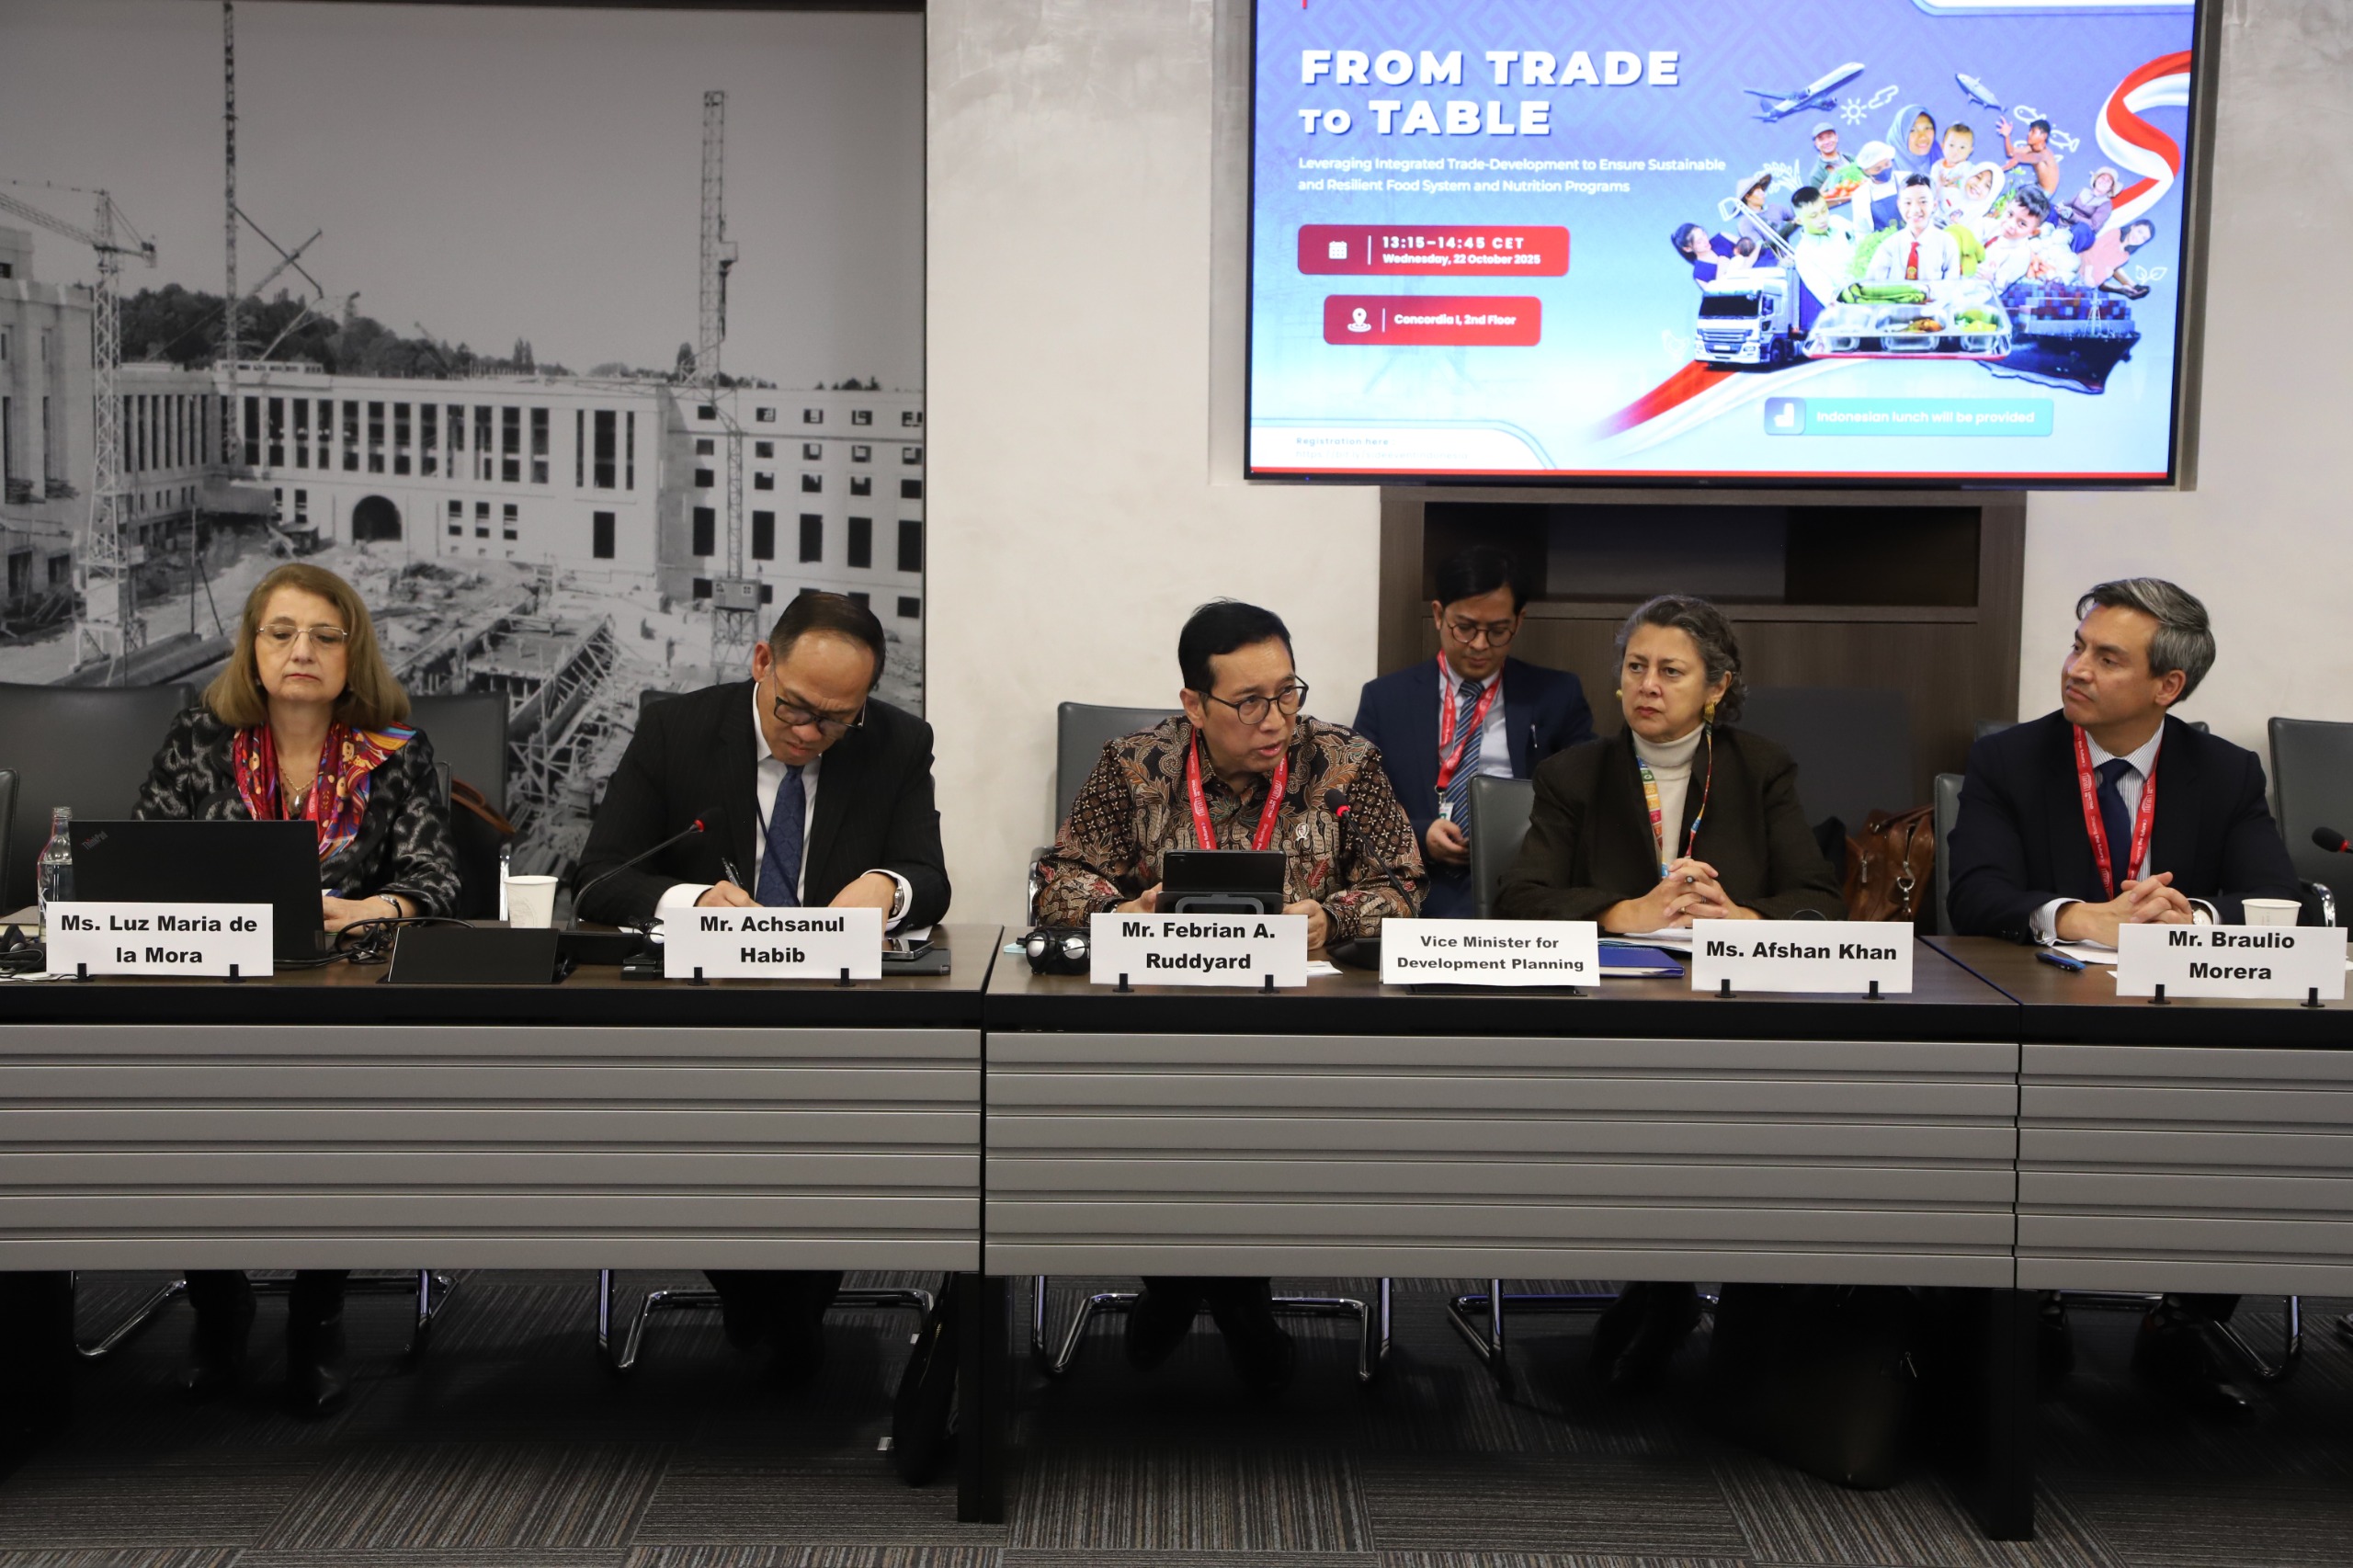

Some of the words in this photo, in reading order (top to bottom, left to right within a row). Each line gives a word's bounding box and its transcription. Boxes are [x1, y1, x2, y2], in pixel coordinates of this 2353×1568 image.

[1302, 50, 1463, 85] FROM
[1485, 51, 1679, 86] TRADE
[1298, 108, 1352, 134] TO
[1369, 100, 1552, 135] TABLE
[1299, 156, 1372, 172] Leveraging
[1375, 157, 1444, 172] Integrated
[1448, 157, 1580, 173] Trade-Development
[1582, 160, 1597, 170] to
[1599, 159, 1645, 170] Ensure
[1648, 158, 1726, 171] Sustainable
[1298, 179, 1324, 191] and
[1326, 179, 1383, 191] Resilient
[1386, 180, 1420, 191] Food
[1422, 180, 1471, 195] System
[1473, 180, 1500, 191] and
[1503, 179, 1562, 192] Nutrition
[1564, 180, 1631, 195] Programs
[1492, 237, 1524, 249] CET
[1382, 254, 1452, 267] Wednesday,
[1453, 255, 1466, 264] 22
[1468, 255, 1512, 265] October
[1514, 255, 1541, 265] 2025
[1394, 313, 1454, 324] Concordia
[1464, 314, 1486, 324] 2nd
[1487, 314, 1517, 325] Floor
[1816, 411, 1889, 423] Indonesian
[1893, 412, 1929, 423] lunch
[1932, 411, 1953, 423] will
[1957, 412, 1973, 423] be
[1975, 411, 2035, 426] provided
[1296, 437, 1362, 447] Registration
[1365, 437, 1389, 446] here
[61, 915, 100, 931] Ms.
[109, 915, 150, 931] Luz
[157, 915, 222, 932] Maria
[229, 915, 257, 932] de
[700, 915, 733, 932] Mr.
[740, 915, 845, 932] Achsanul
[1122, 921, 1154, 937] Mr.
[1163, 922, 1245, 938] Febrian
[1253, 923, 1276, 938] A.
[1420, 936, 1458, 948] Vice
[1463, 936, 1531, 949] Minister
[1536, 936, 1559, 949] for
[2168, 930, 2202, 947] Mr.
[2211, 931, 2295, 949] Braulio
[116, 947, 137, 963] la
[145, 947, 202, 963] Mora
[740, 947, 805, 963] Habib
[1706, 940, 1745, 958] Ms.
[1752, 941, 1831, 959] Afshan
[1838, 943, 1897, 960] Khan
[1146, 952, 1251, 973] Ruddyard
[1397, 957, 1506, 972] Development
[1512, 959, 1584, 973] Planning
[2189, 962, 2272, 980] Morera
